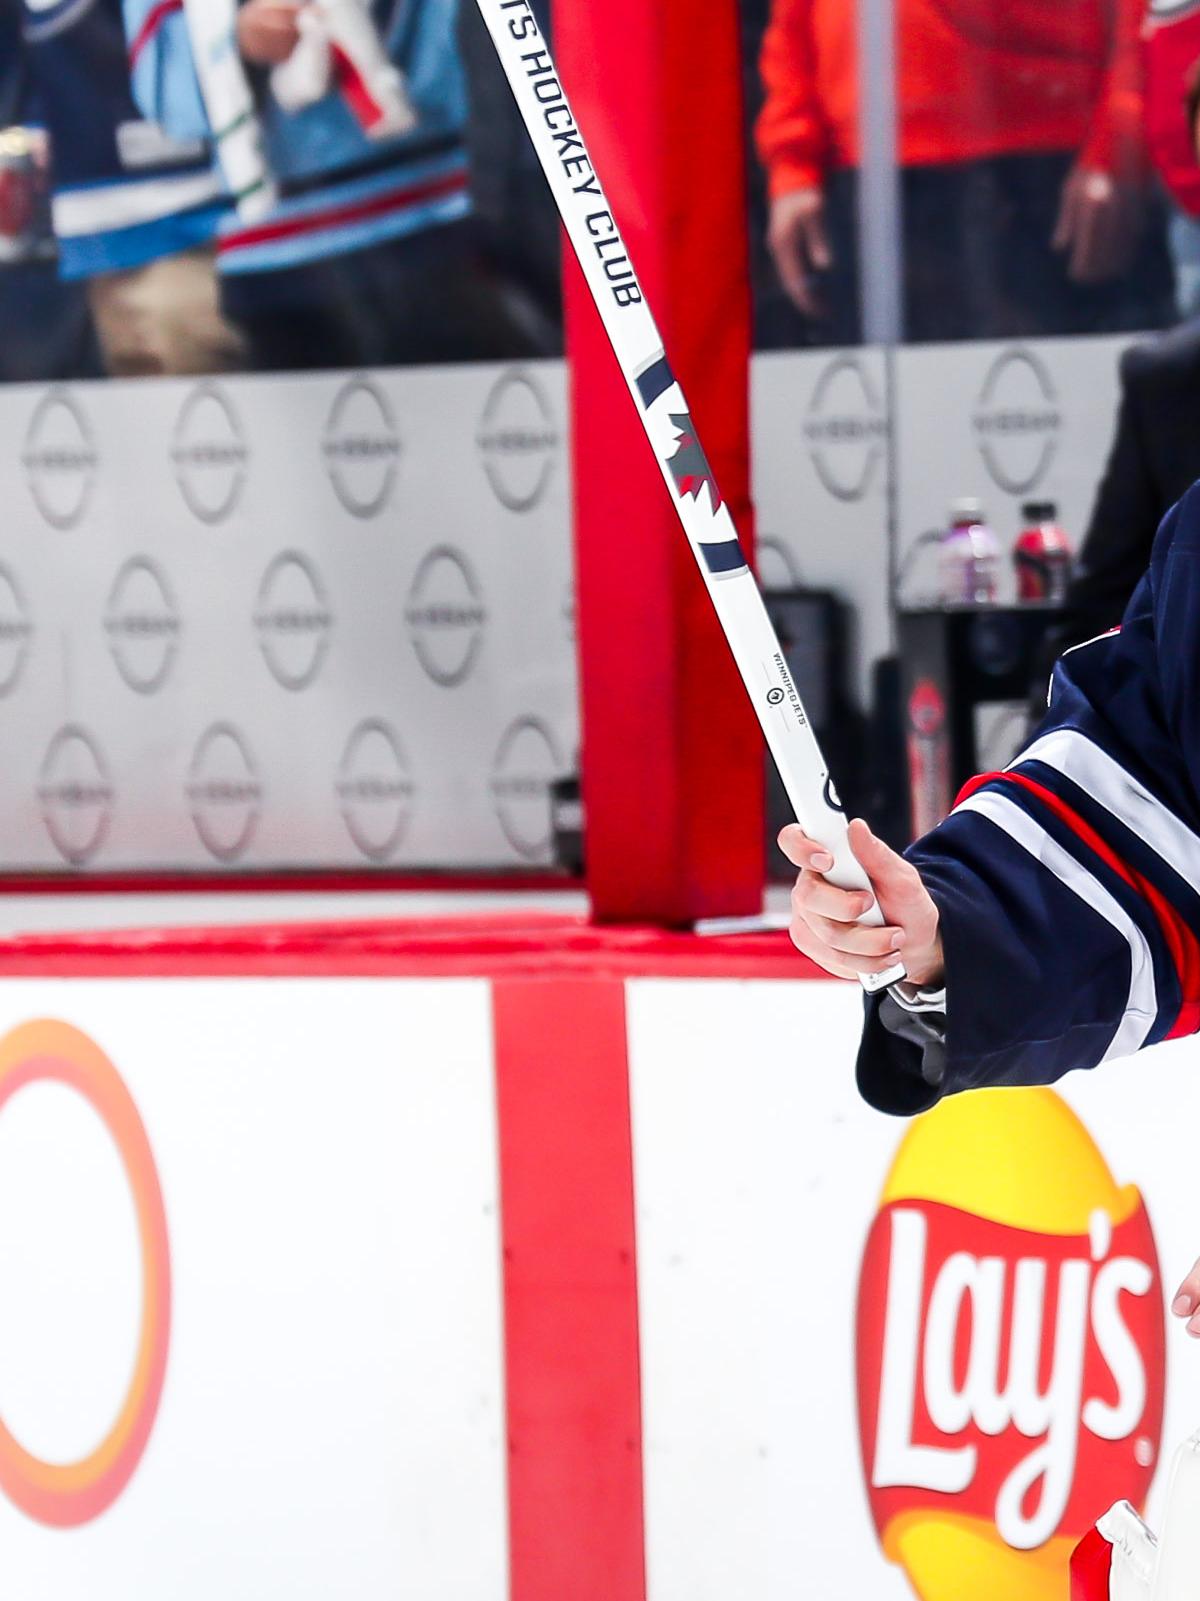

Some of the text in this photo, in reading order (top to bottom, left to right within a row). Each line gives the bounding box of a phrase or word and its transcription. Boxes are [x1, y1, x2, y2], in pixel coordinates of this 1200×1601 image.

[500, 0, 643, 307] TS HOCKEY CLUB
[792, 703, 806, 725] JETS
[872, 1207, 1152, 1552] Lay's
